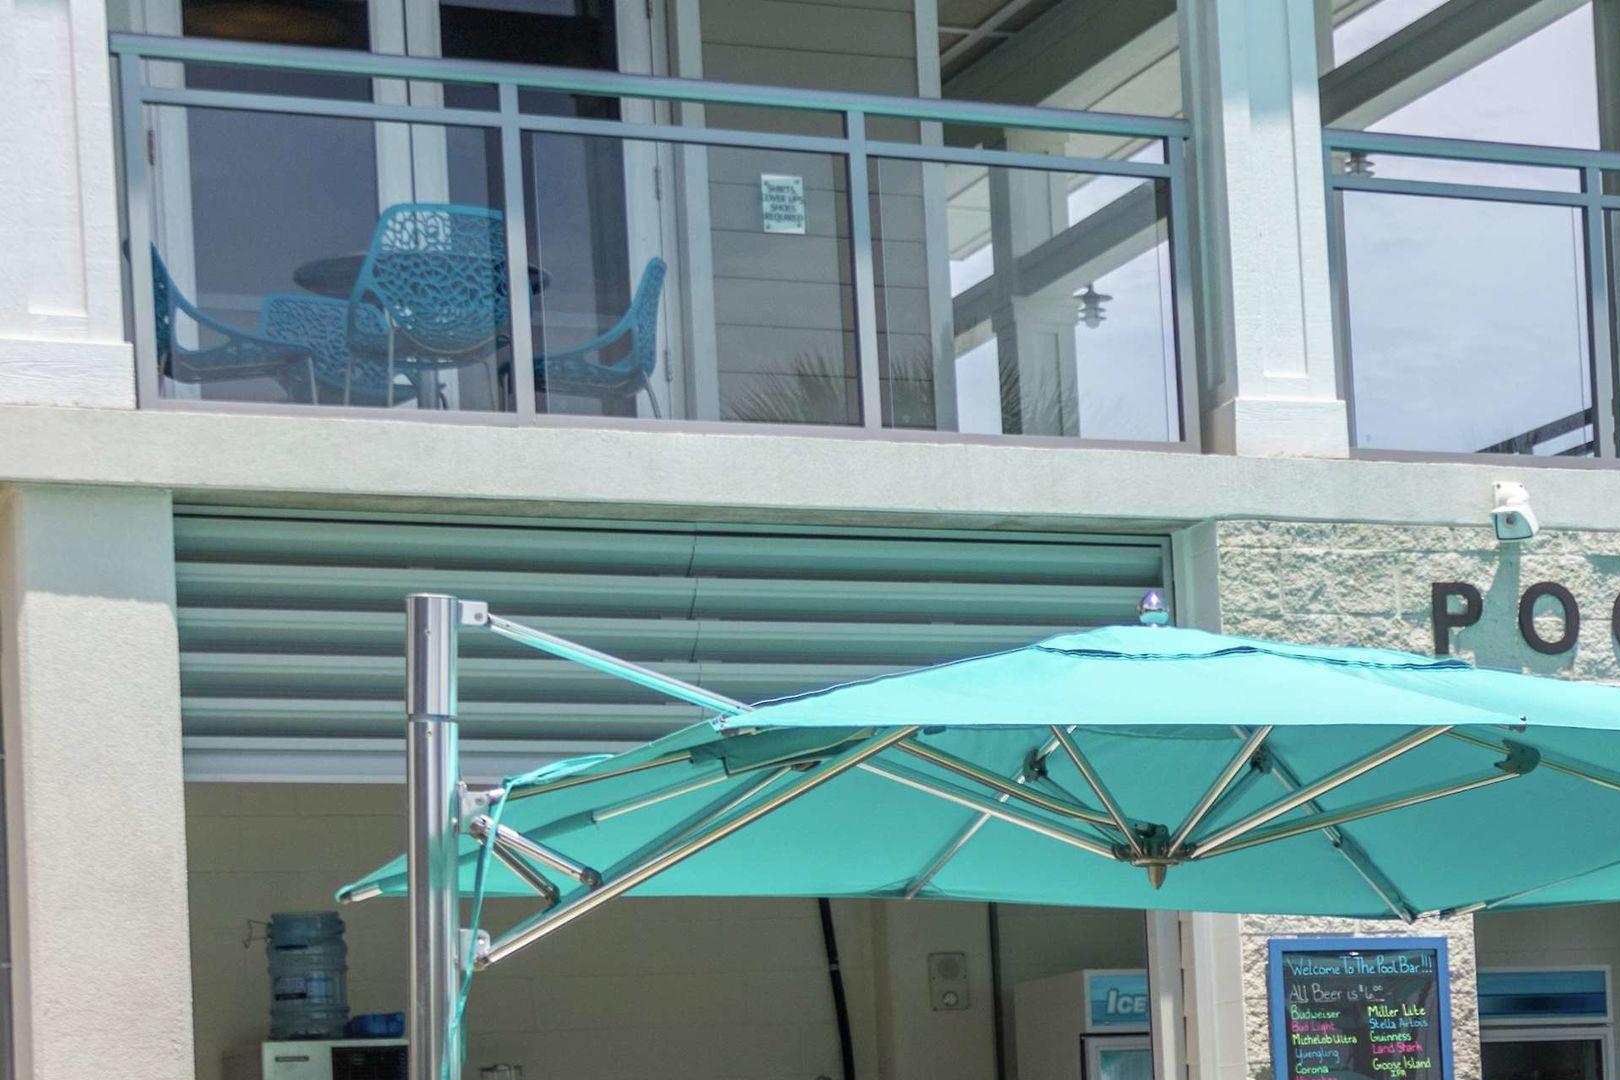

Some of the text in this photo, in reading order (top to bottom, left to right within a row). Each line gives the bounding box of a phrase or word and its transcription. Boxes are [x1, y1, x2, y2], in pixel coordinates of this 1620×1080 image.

[1287, 957, 1340, 976] Welcome
[1340, 956, 1353, 974] To
[1354, 956, 1376, 974] The
[1376, 955, 1398, 974] Pool
[1290, 984, 1309, 1001] All
[1312, 983, 1342, 1001] Beer
[1347, 988, 1358, 1000] is
[1291, 1004, 1341, 1019] Budweiser
[1368, 1003, 1426, 1017] Miller Lite
[1291, 1020, 1335, 1033] Bud Light
[1369, 1018, 1396, 1029] Stella
[1333, 1034, 1357, 1045] Ultra
[1370, 1030, 1411, 1042] Guinness
[1372, 1041, 1423, 1054] Land Shark
[1296, 1063, 1329, 1074] Corona
[1373, 1055, 1431, 1071] Goose Island
